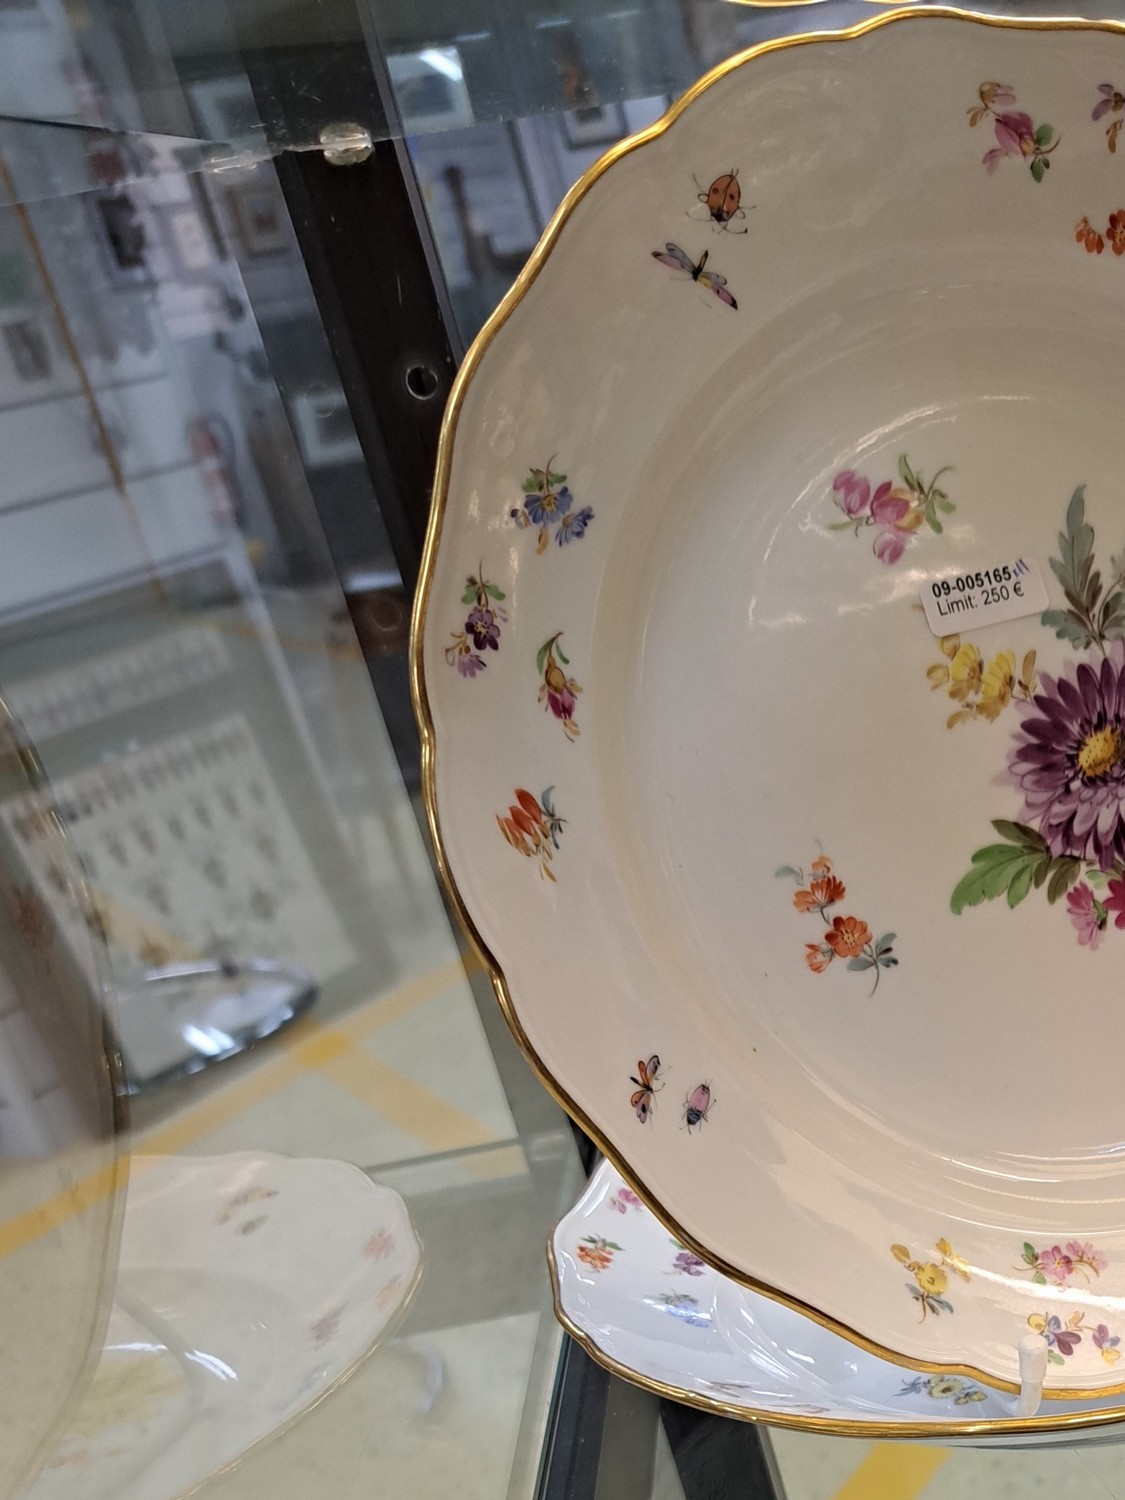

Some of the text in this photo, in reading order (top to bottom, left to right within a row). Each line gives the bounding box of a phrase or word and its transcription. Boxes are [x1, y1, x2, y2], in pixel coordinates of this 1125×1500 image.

[932, 566, 1012, 598] 09-005165
[936, 581, 1025, 616] Limit: 250 €
